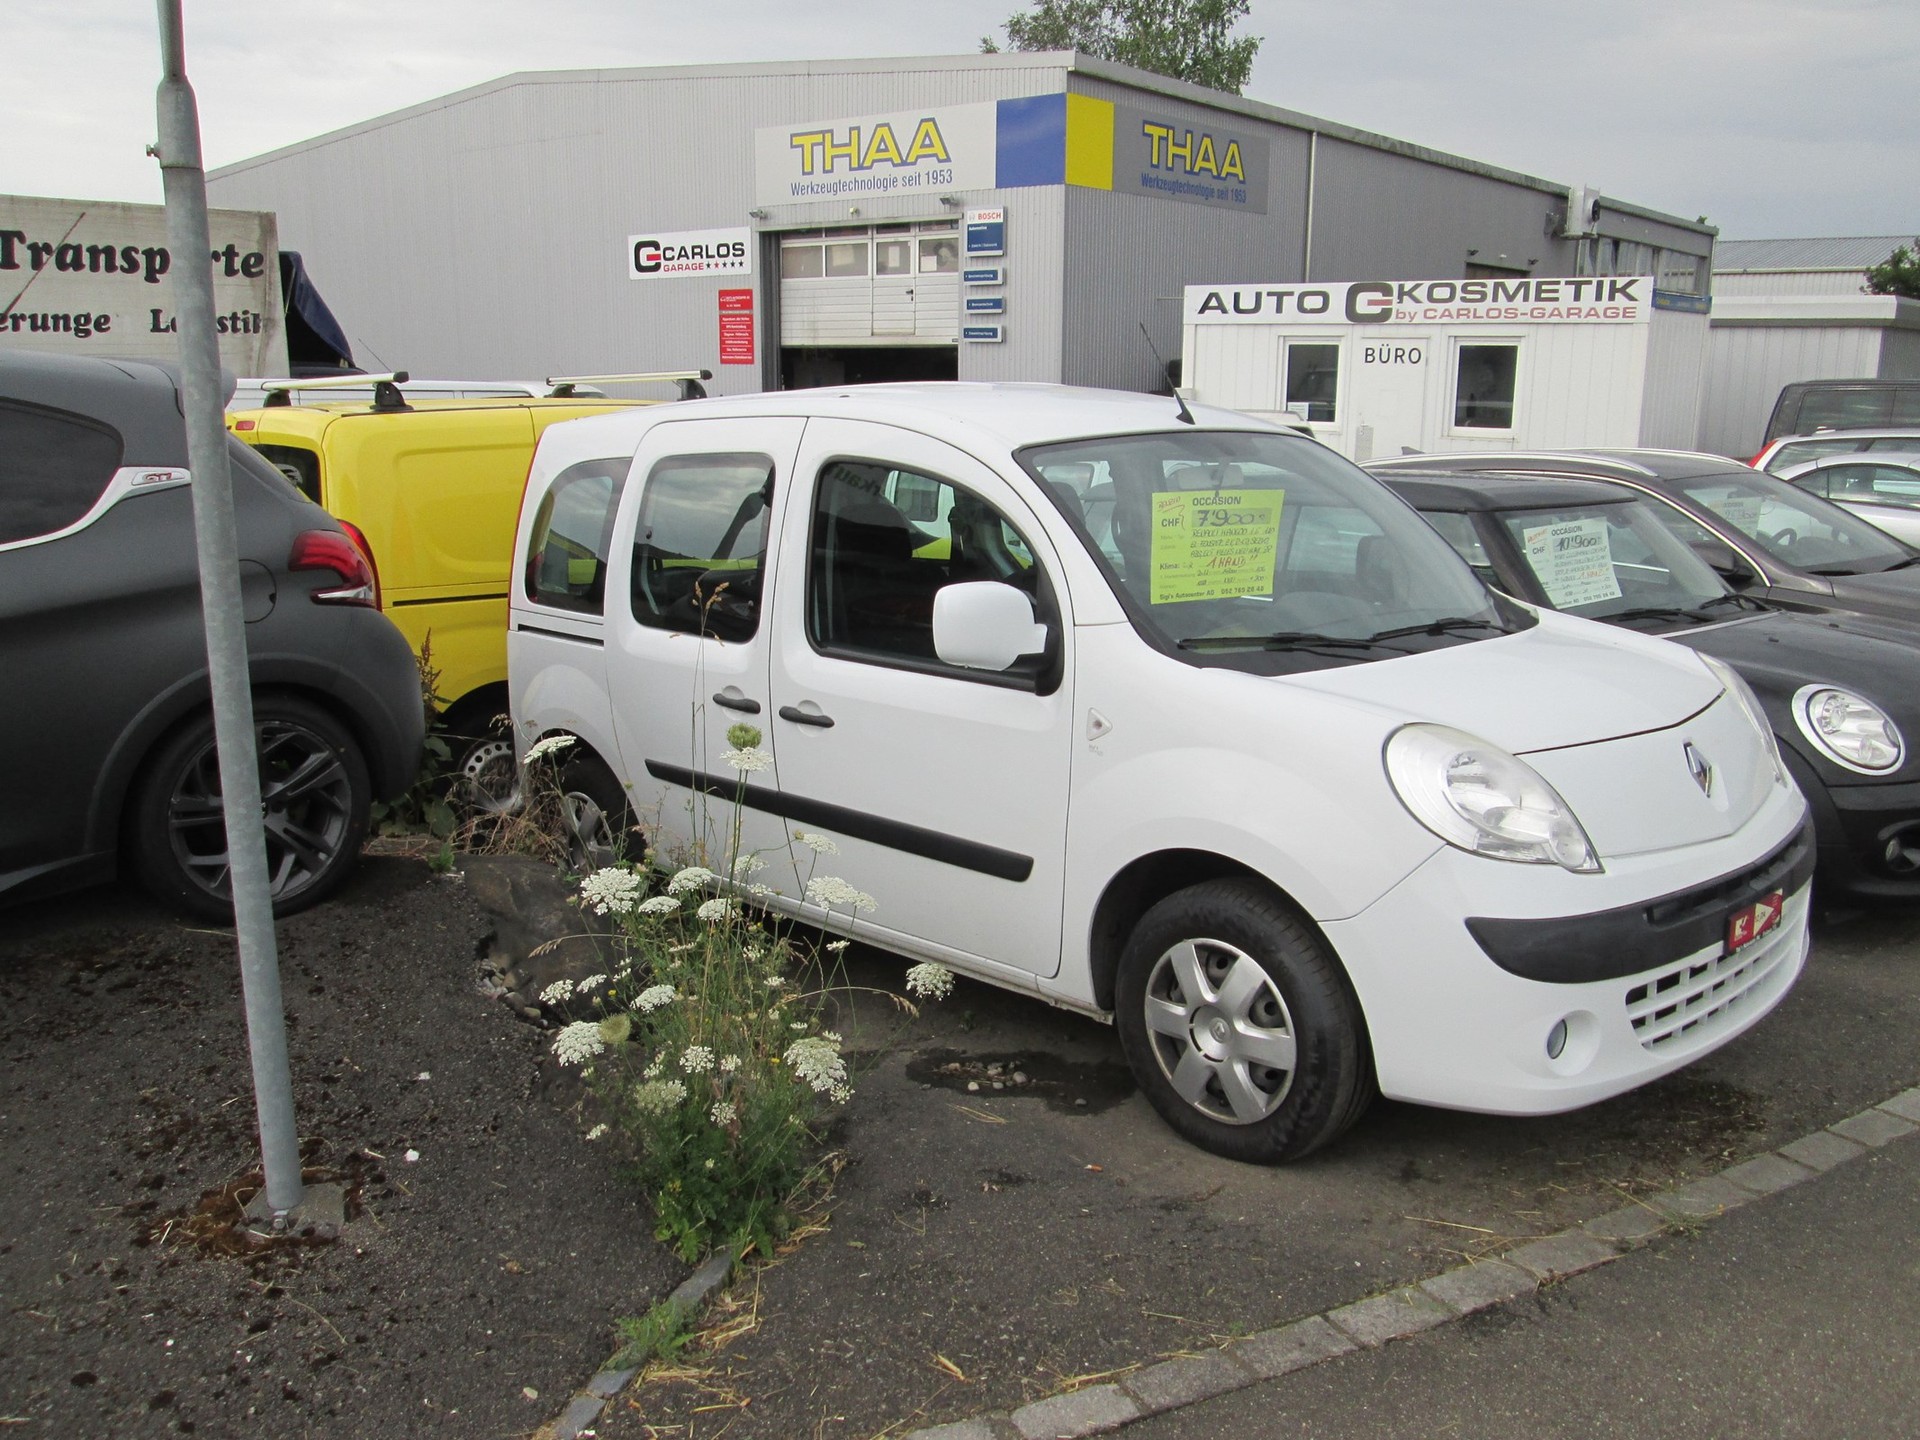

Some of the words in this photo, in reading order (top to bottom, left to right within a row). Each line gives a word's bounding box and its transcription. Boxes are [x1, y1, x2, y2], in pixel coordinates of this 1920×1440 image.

[790, 117, 952, 176] THAA
[1142, 120, 1246, 184] THAA
[791, 173, 898, 196] Werkzeugtechnologie
[901, 171, 921, 187] seit
[924, 168, 953, 185] 1953
[977, 212, 1002, 221] BOSCH
[0, 229, 264, 284] Transpte
[662, 241, 746, 262] CARLOS
[663, 262, 705, 273] GARAGE
[1198, 289, 1331, 315] AUTO
[1396, 278, 1640, 305] KOSMETIK
[150, 308, 262, 335] Lsti
[1395, 308, 1418, 323] by
[1423, 306, 1638, 320] CARLOS-GARAGE
[1364, 343, 1422, 365] BÜRO
[1192, 496, 1242, 507] OCCASION
[1161, 518, 1180, 528] CHF
[1551, 525, 1583, 537] OCCASION
